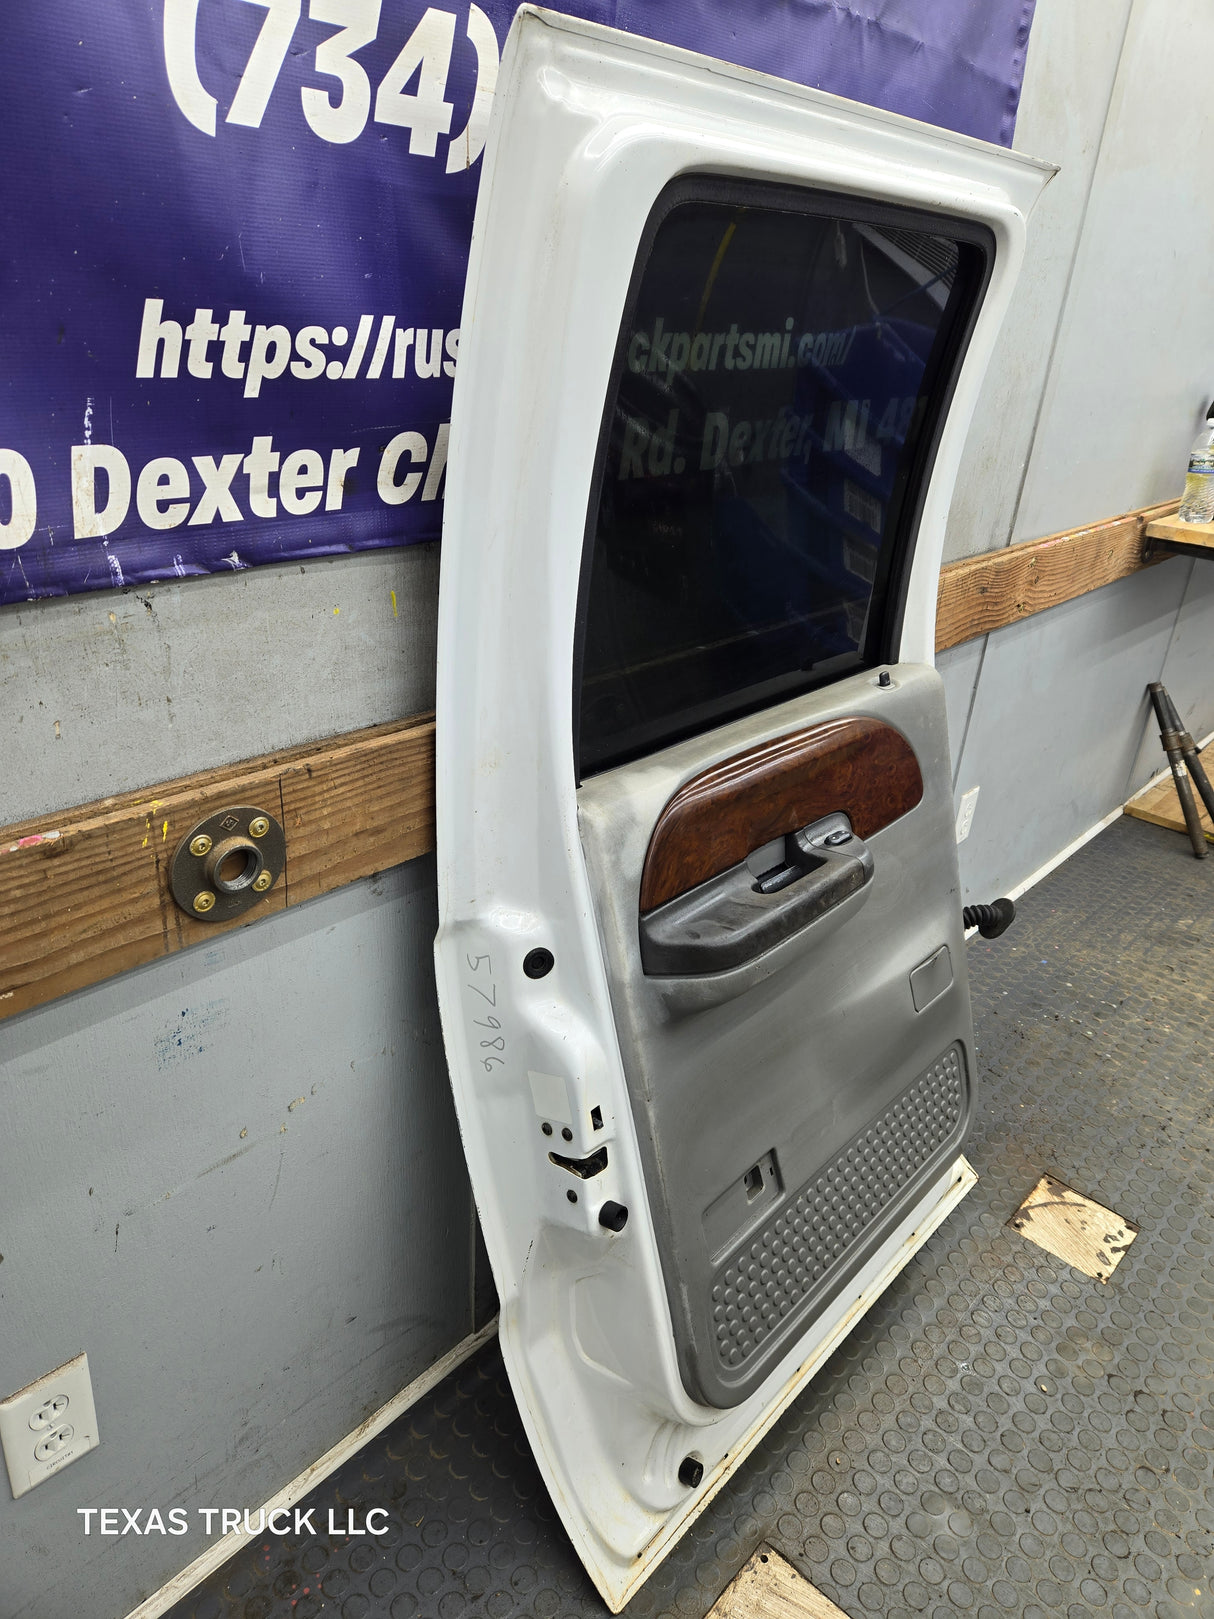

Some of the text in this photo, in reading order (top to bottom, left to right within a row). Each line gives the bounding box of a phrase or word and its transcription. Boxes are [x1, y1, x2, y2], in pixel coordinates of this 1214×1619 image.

[163, 0, 501, 174] (734)
[135, 298, 461, 399] https://rus
[71, 435, 360, 540] Dexter
[466, 952, 505, 1073] 57986
